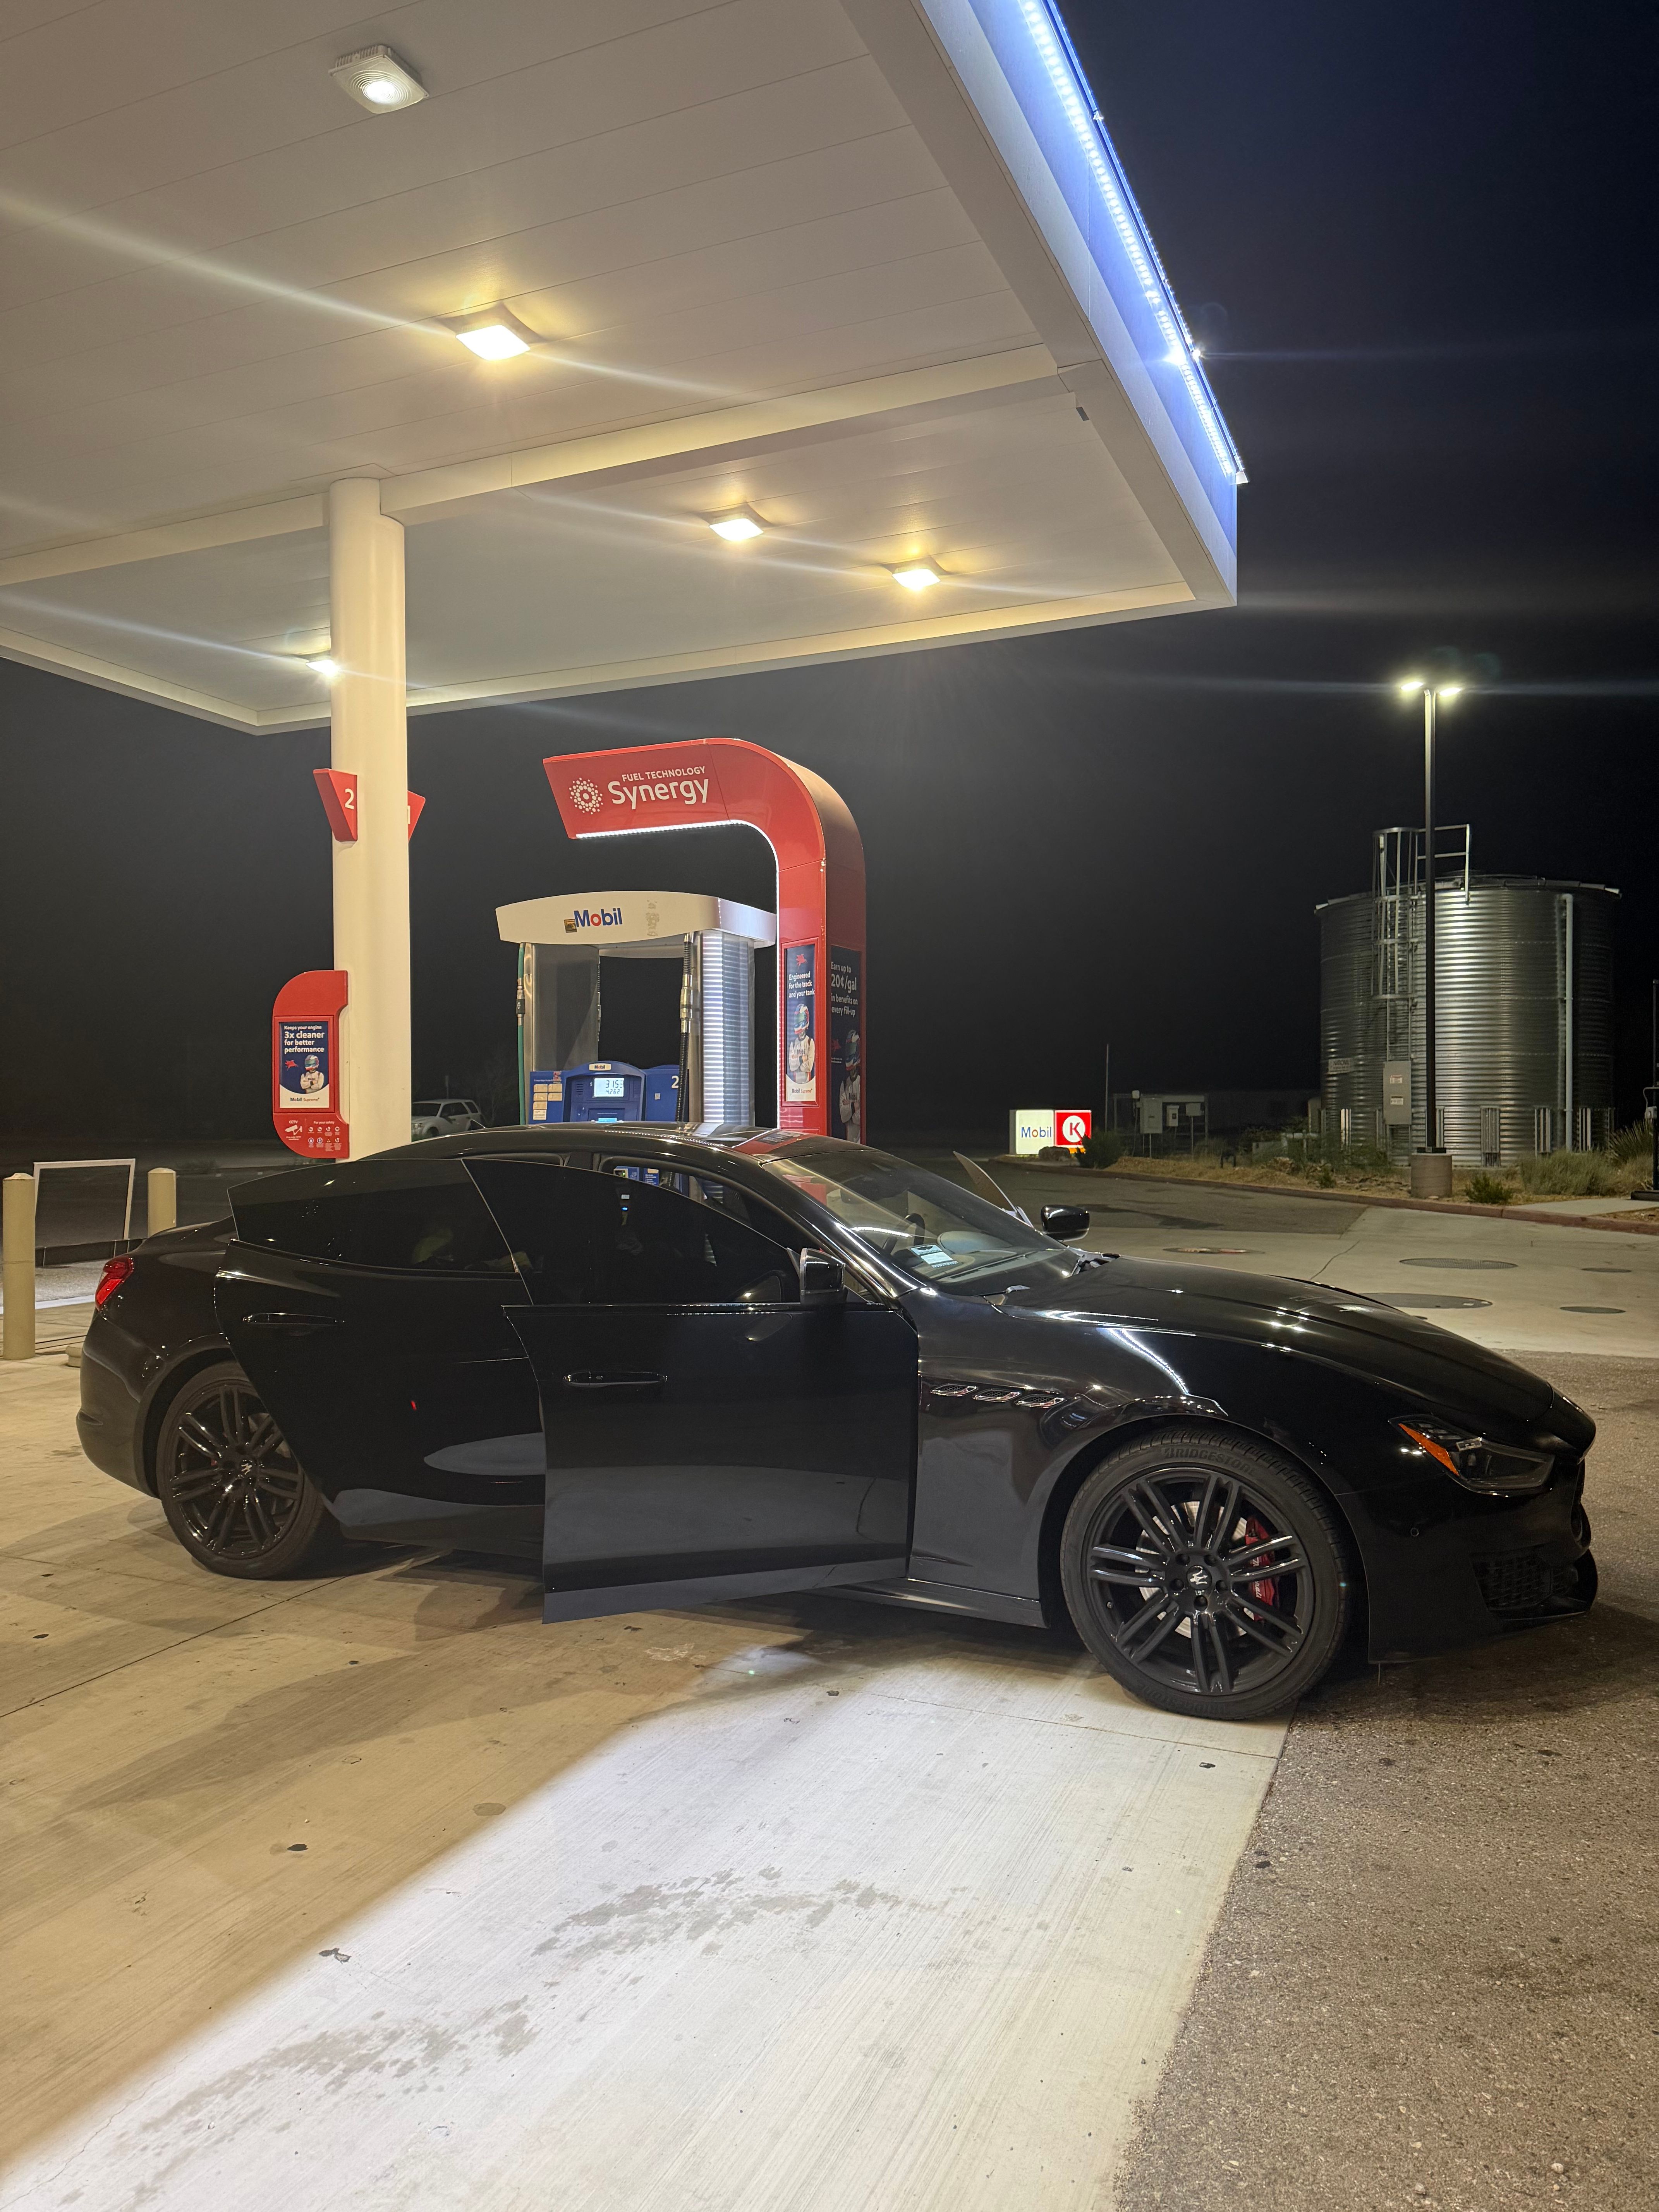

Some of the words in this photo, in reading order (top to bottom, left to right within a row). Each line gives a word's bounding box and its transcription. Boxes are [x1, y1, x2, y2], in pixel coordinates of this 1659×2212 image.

[622, 772, 644, 782] FUEL
[645, 766, 706, 780] TECHNOLOGY
[345, 788, 354, 810] 2
[608, 779, 709, 810] Synergy
[574, 907, 623, 927] Mobil
[831, 962, 840, 970] Earn
[841, 965, 846, 974] up
[847, 965, 852, 973] to
[789, 971, 811, 982] Engineered
[831, 973, 857, 993] 20¢/gal
[831, 993, 835, 1002] in
[836, 994, 852, 1004] benefits
[831, 1006, 843, 1016] every
[843, 1006, 855, 1018] fill-up
[284, 1046, 324, 1054] performance
[672, 1075, 679, 1089] 2
[1021, 1126, 1052, 1138] Mobil
[1069, 1122, 1083, 1139] K
